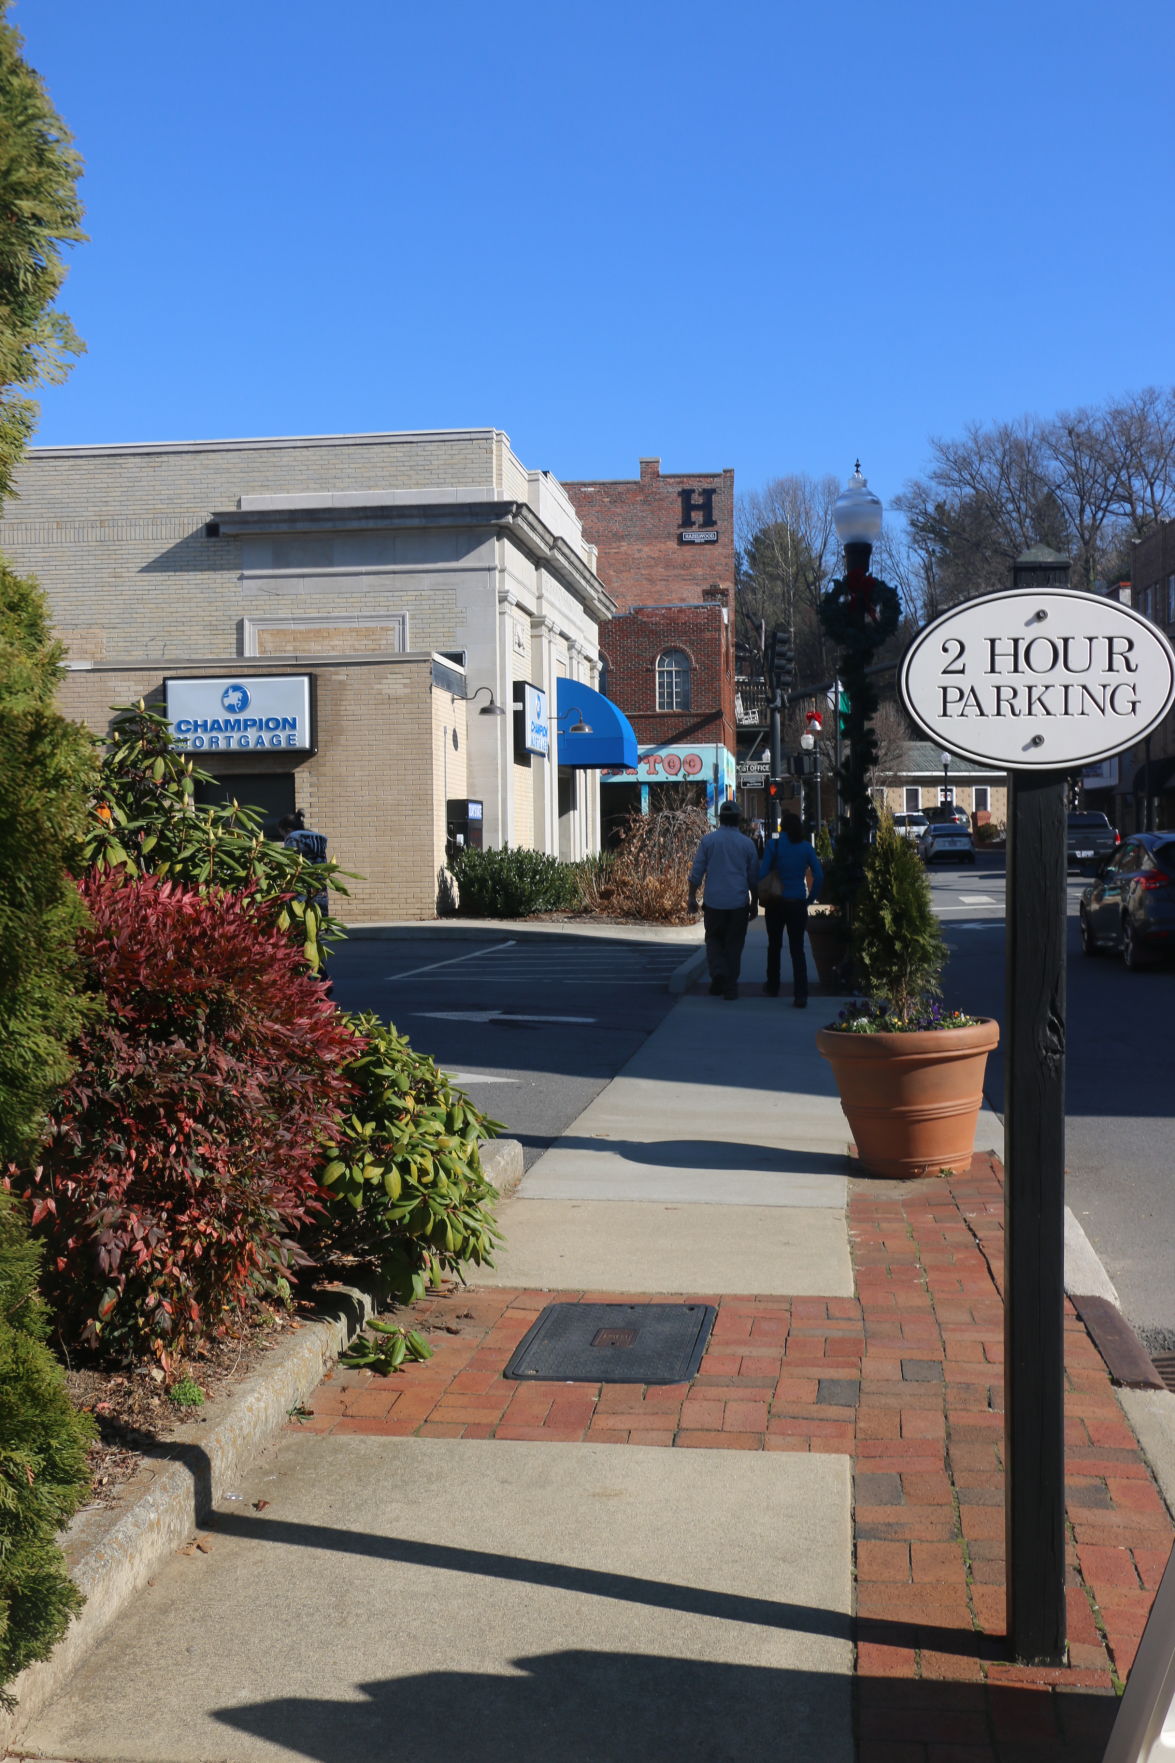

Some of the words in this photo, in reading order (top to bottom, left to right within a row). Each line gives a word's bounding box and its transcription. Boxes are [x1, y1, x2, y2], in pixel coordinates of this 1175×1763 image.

[678, 488, 717, 528] H
[941, 638, 966, 675] 2
[983, 636, 1138, 674] HOUR
[937, 683, 1141, 718] PARKING
[176, 717, 297, 734] CHAMPION
